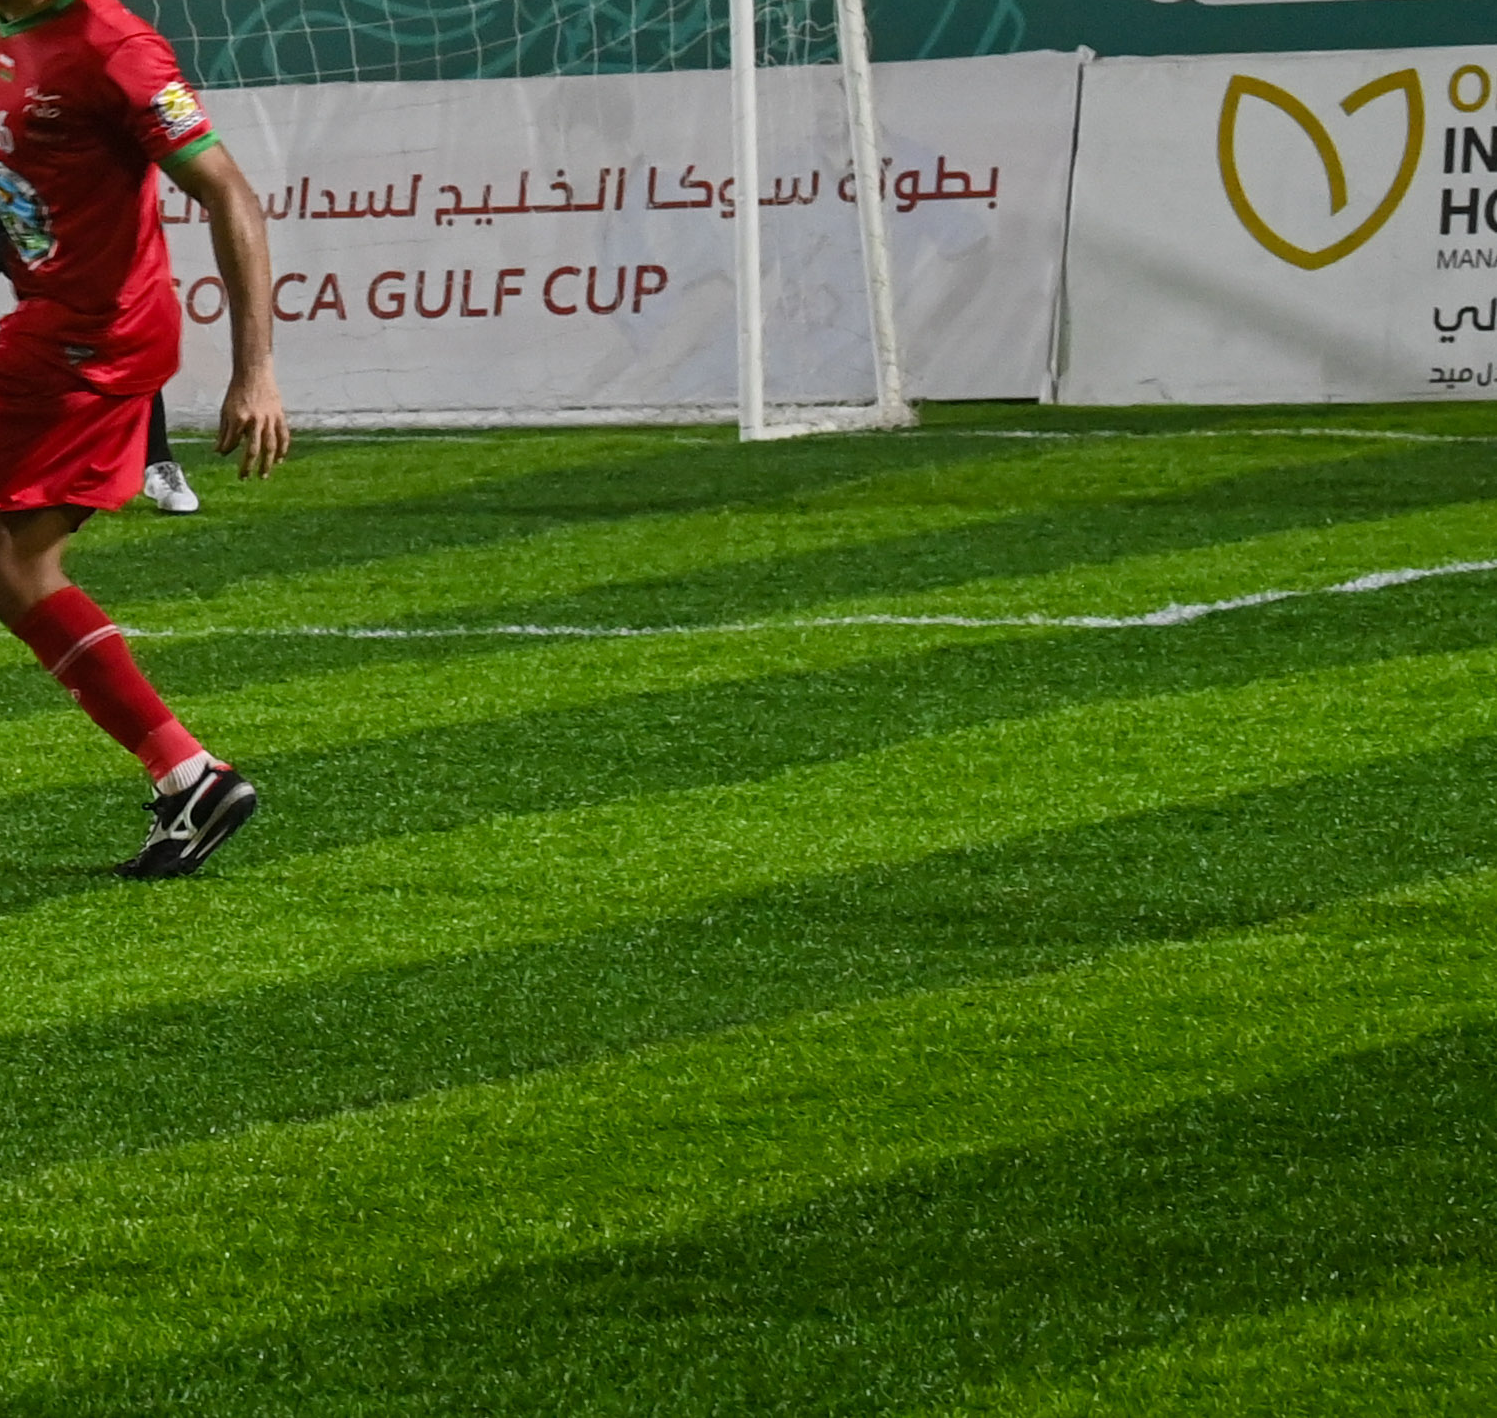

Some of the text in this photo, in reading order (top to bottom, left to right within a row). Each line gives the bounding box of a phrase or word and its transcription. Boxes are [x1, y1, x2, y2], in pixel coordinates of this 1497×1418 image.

[435, 167, 625, 226] الخليج
[171, 265, 668, 325] OCA GULF CUP
